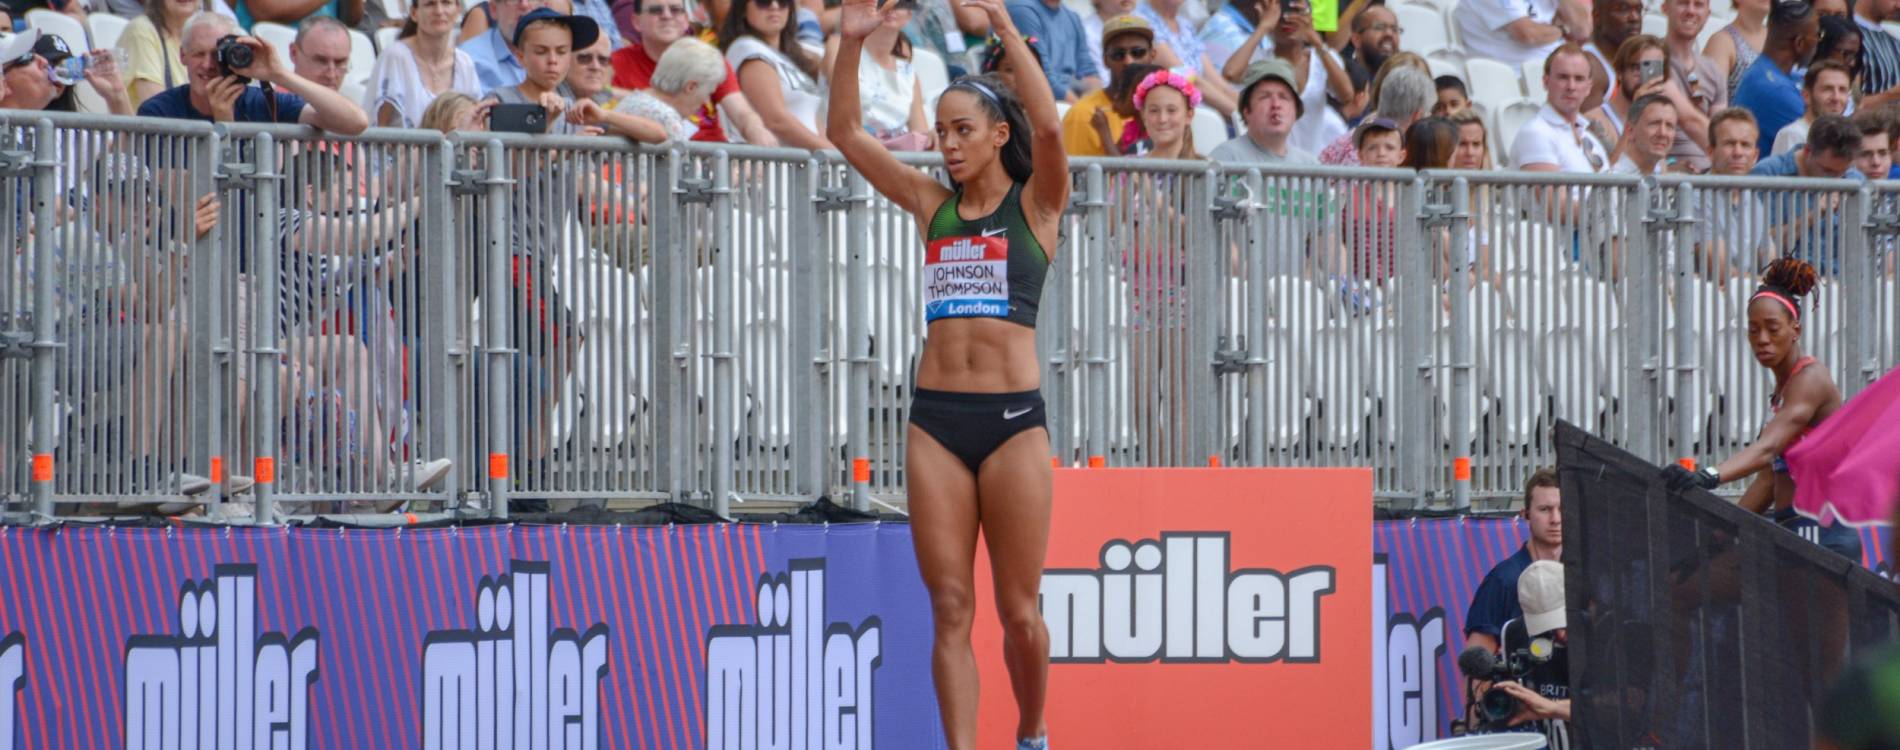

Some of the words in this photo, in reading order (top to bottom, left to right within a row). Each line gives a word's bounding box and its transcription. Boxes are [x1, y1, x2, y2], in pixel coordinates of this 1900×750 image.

[928, 282, 1002, 299] THOMPSON
[933, 265, 994, 284] JOHNSON
[941, 238, 987, 261] müller
[948, 301, 1000, 314] London
[124, 563, 320, 750] müller
[422, 559, 609, 750] müller
[705, 557, 882, 750] müller
[1038, 531, 1336, 664] müller
[1373, 553, 1446, 750] ler
